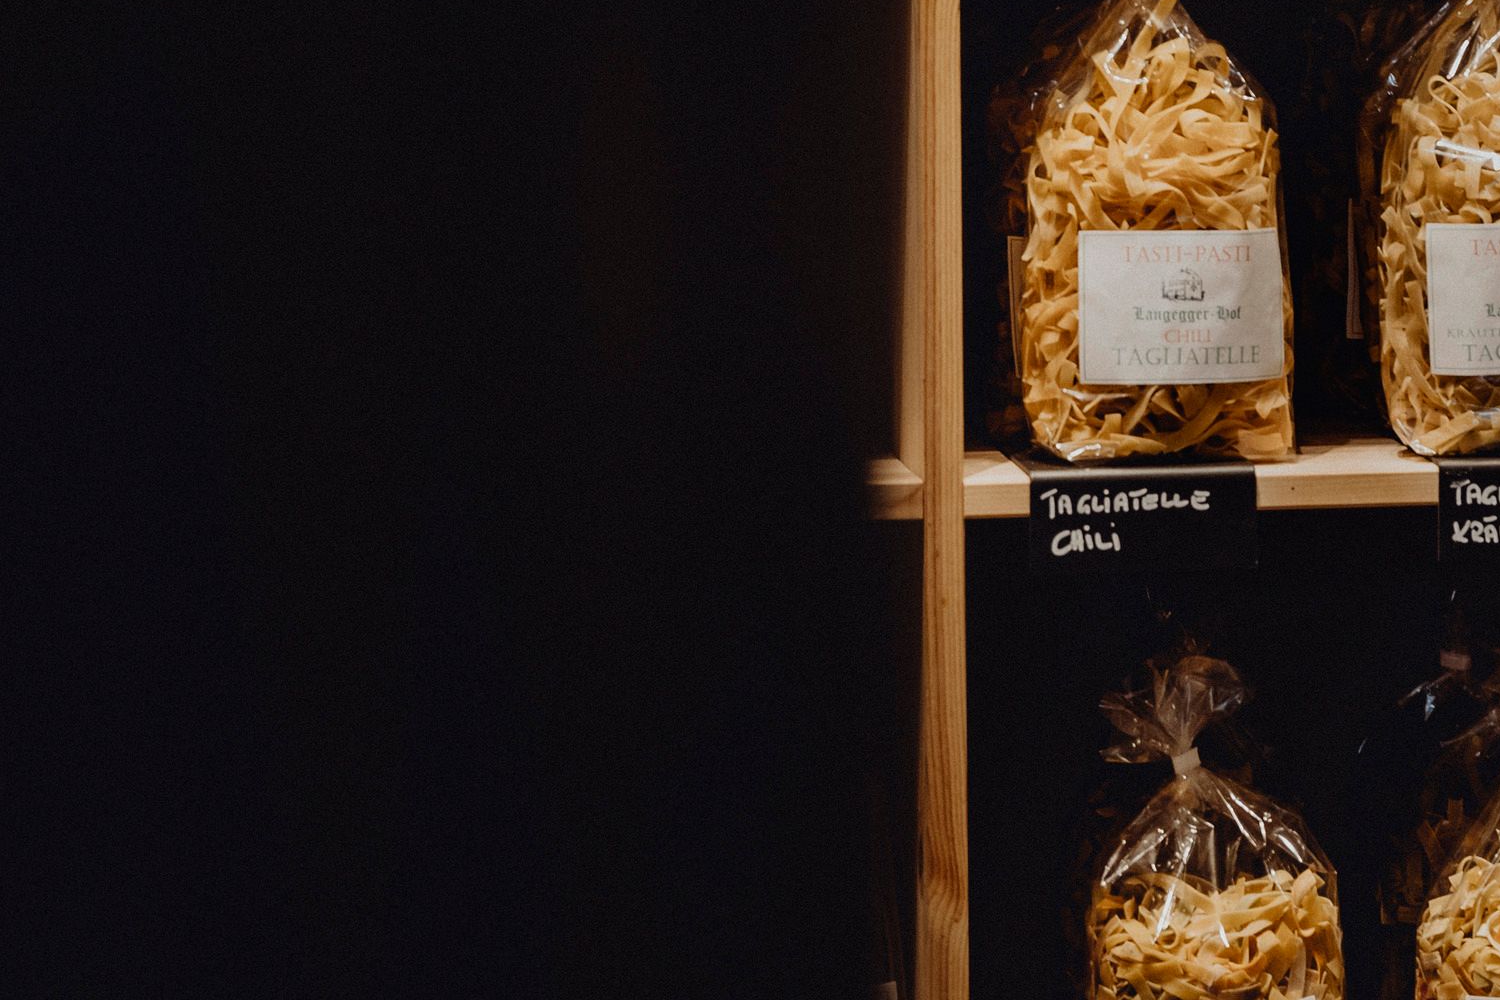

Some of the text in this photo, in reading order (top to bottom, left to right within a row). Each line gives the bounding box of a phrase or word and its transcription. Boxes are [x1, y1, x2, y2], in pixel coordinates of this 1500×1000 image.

[1122, 244, 1251, 263] TASTI-PASTI
[1163, 329, 1212, 344] CHILI
[1111, 345, 1261, 366] TAGLIATELLE
